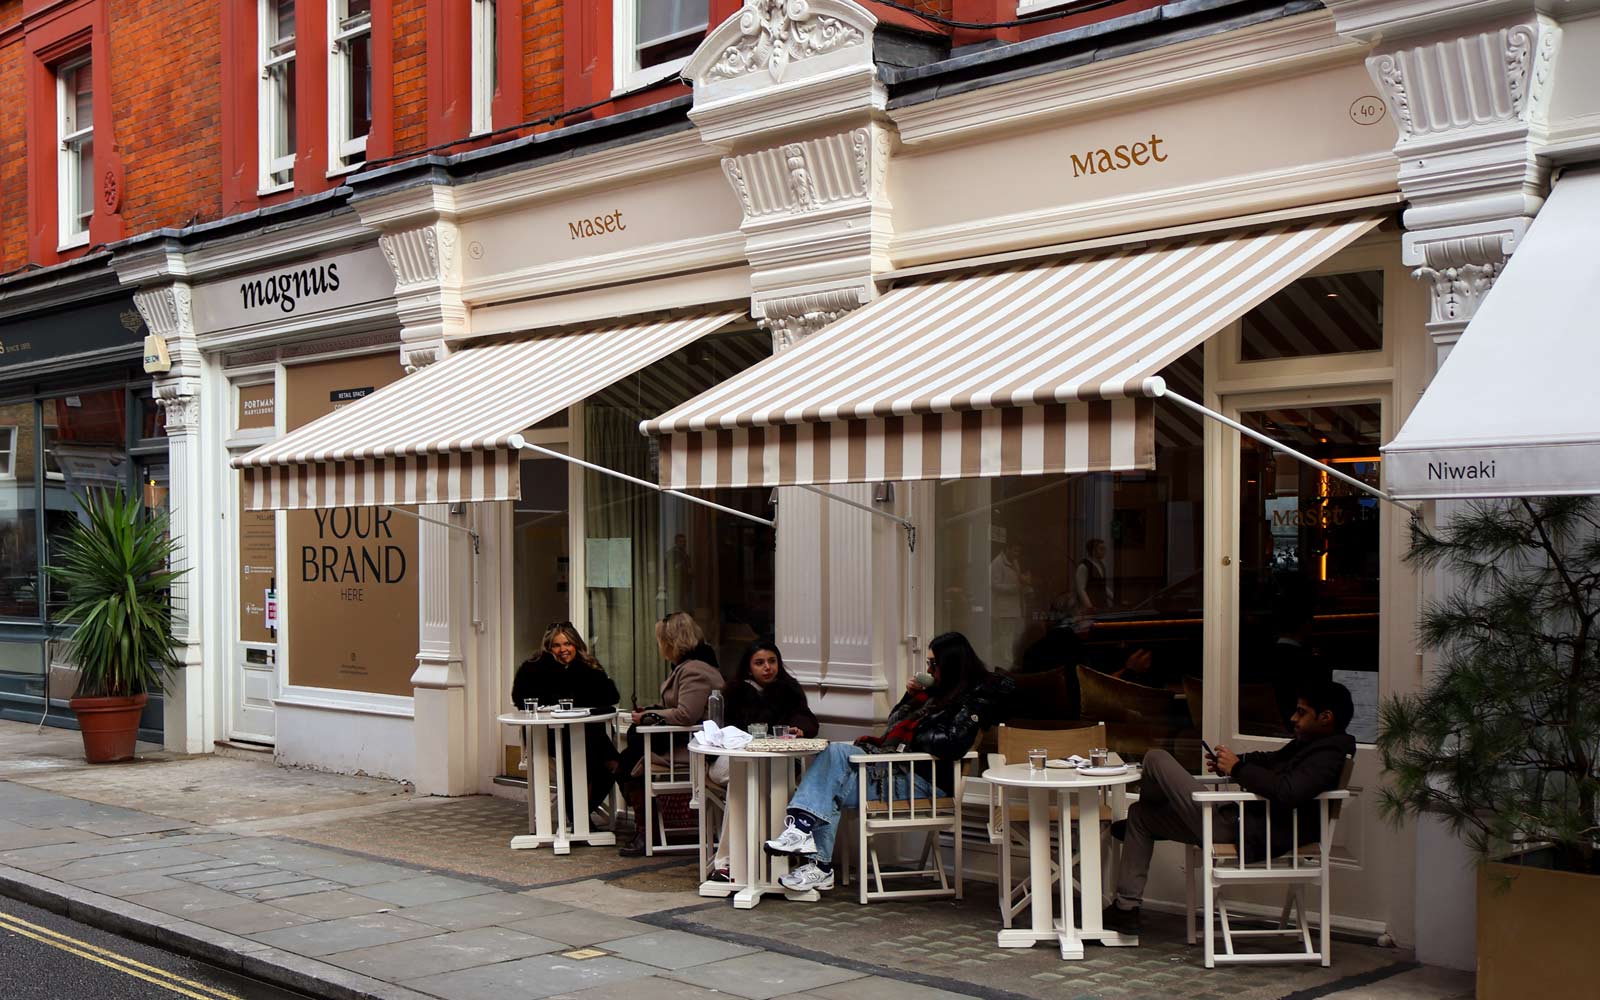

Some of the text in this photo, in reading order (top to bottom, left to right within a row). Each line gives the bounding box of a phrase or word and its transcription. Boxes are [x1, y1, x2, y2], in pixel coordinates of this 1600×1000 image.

[1360, 105, 1375, 117] 40
[240, 263, 340, 312] magnus
[352, 390, 366, 398] SPACE
[244, 398, 274, 409] PORTMAN
[1428, 460, 1495, 480] Niwaki
[314, 506, 392, 538] YOUR
[302, 545, 406, 583] BRAND
[341, 588, 363, 601] HERE
